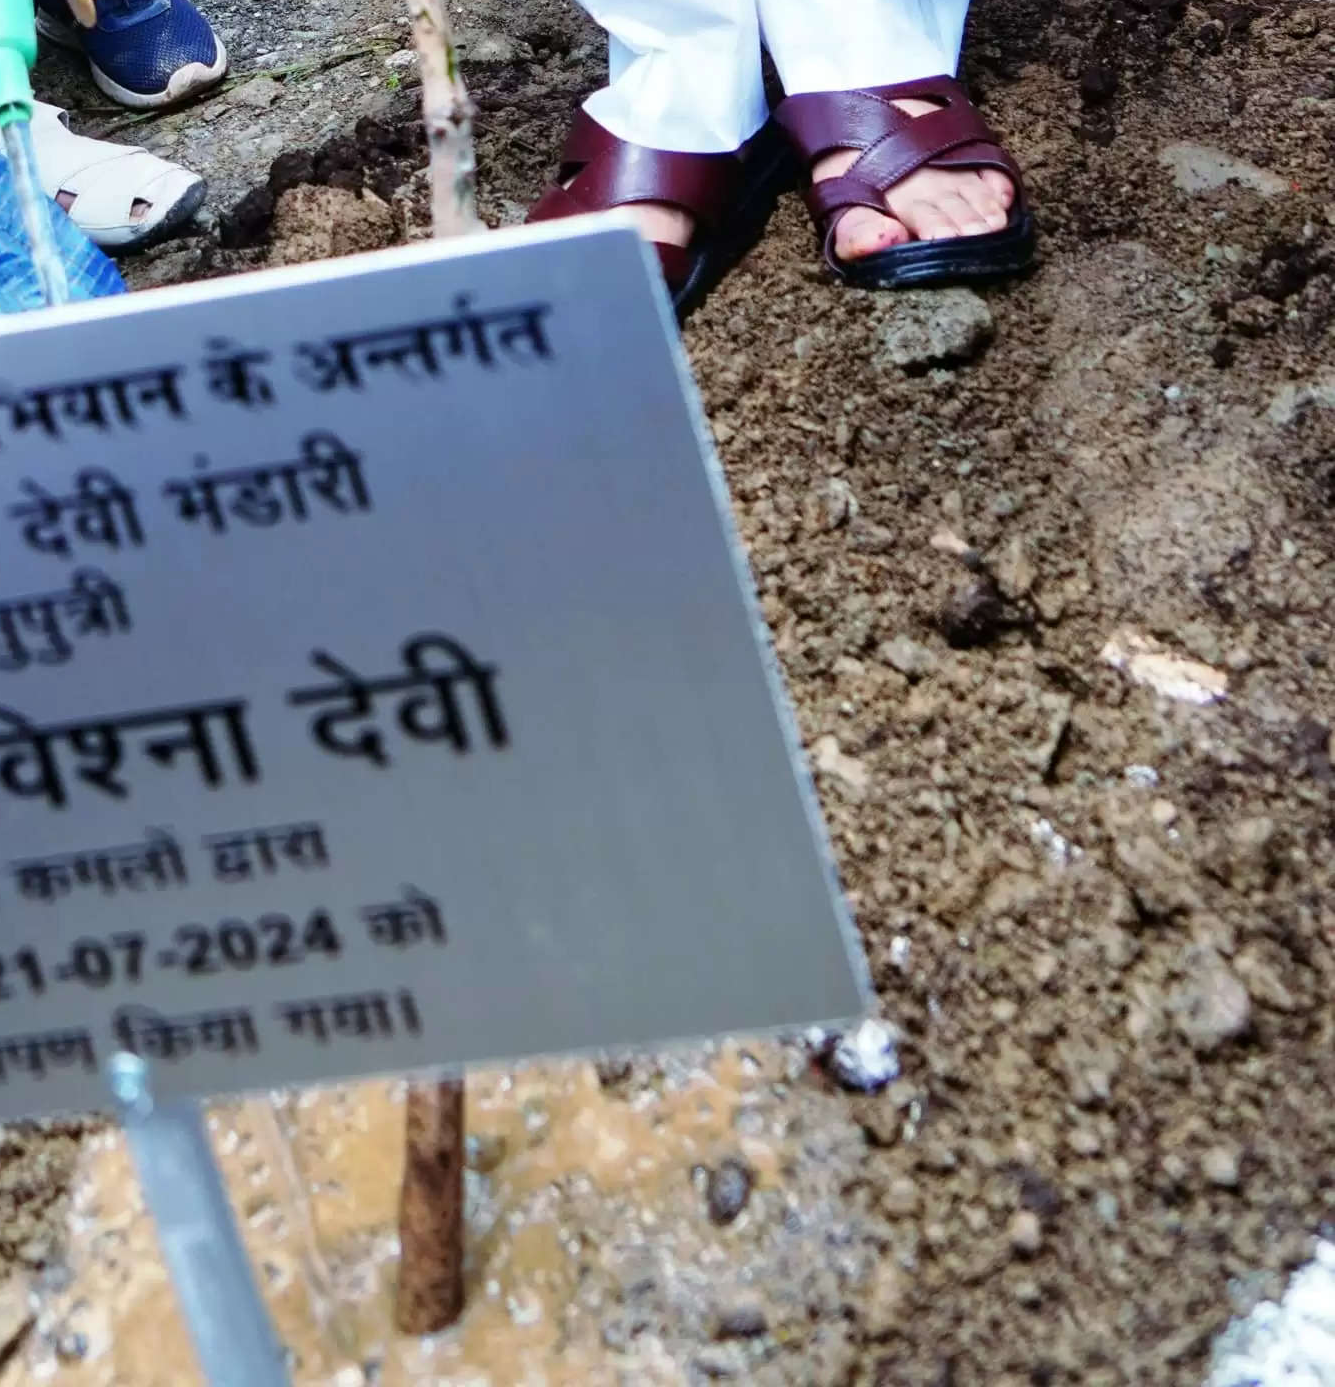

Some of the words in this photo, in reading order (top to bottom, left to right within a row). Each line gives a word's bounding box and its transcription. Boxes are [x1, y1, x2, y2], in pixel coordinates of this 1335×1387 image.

[203, 335, 277, 409] के
[6, 467, 145, 562] देवी
[161, 429, 373, 535] भंडारी
[285, 630, 513, 771] देवी
[359, 882, 450, 951] को
[110, 1002, 264, 1061] किया
